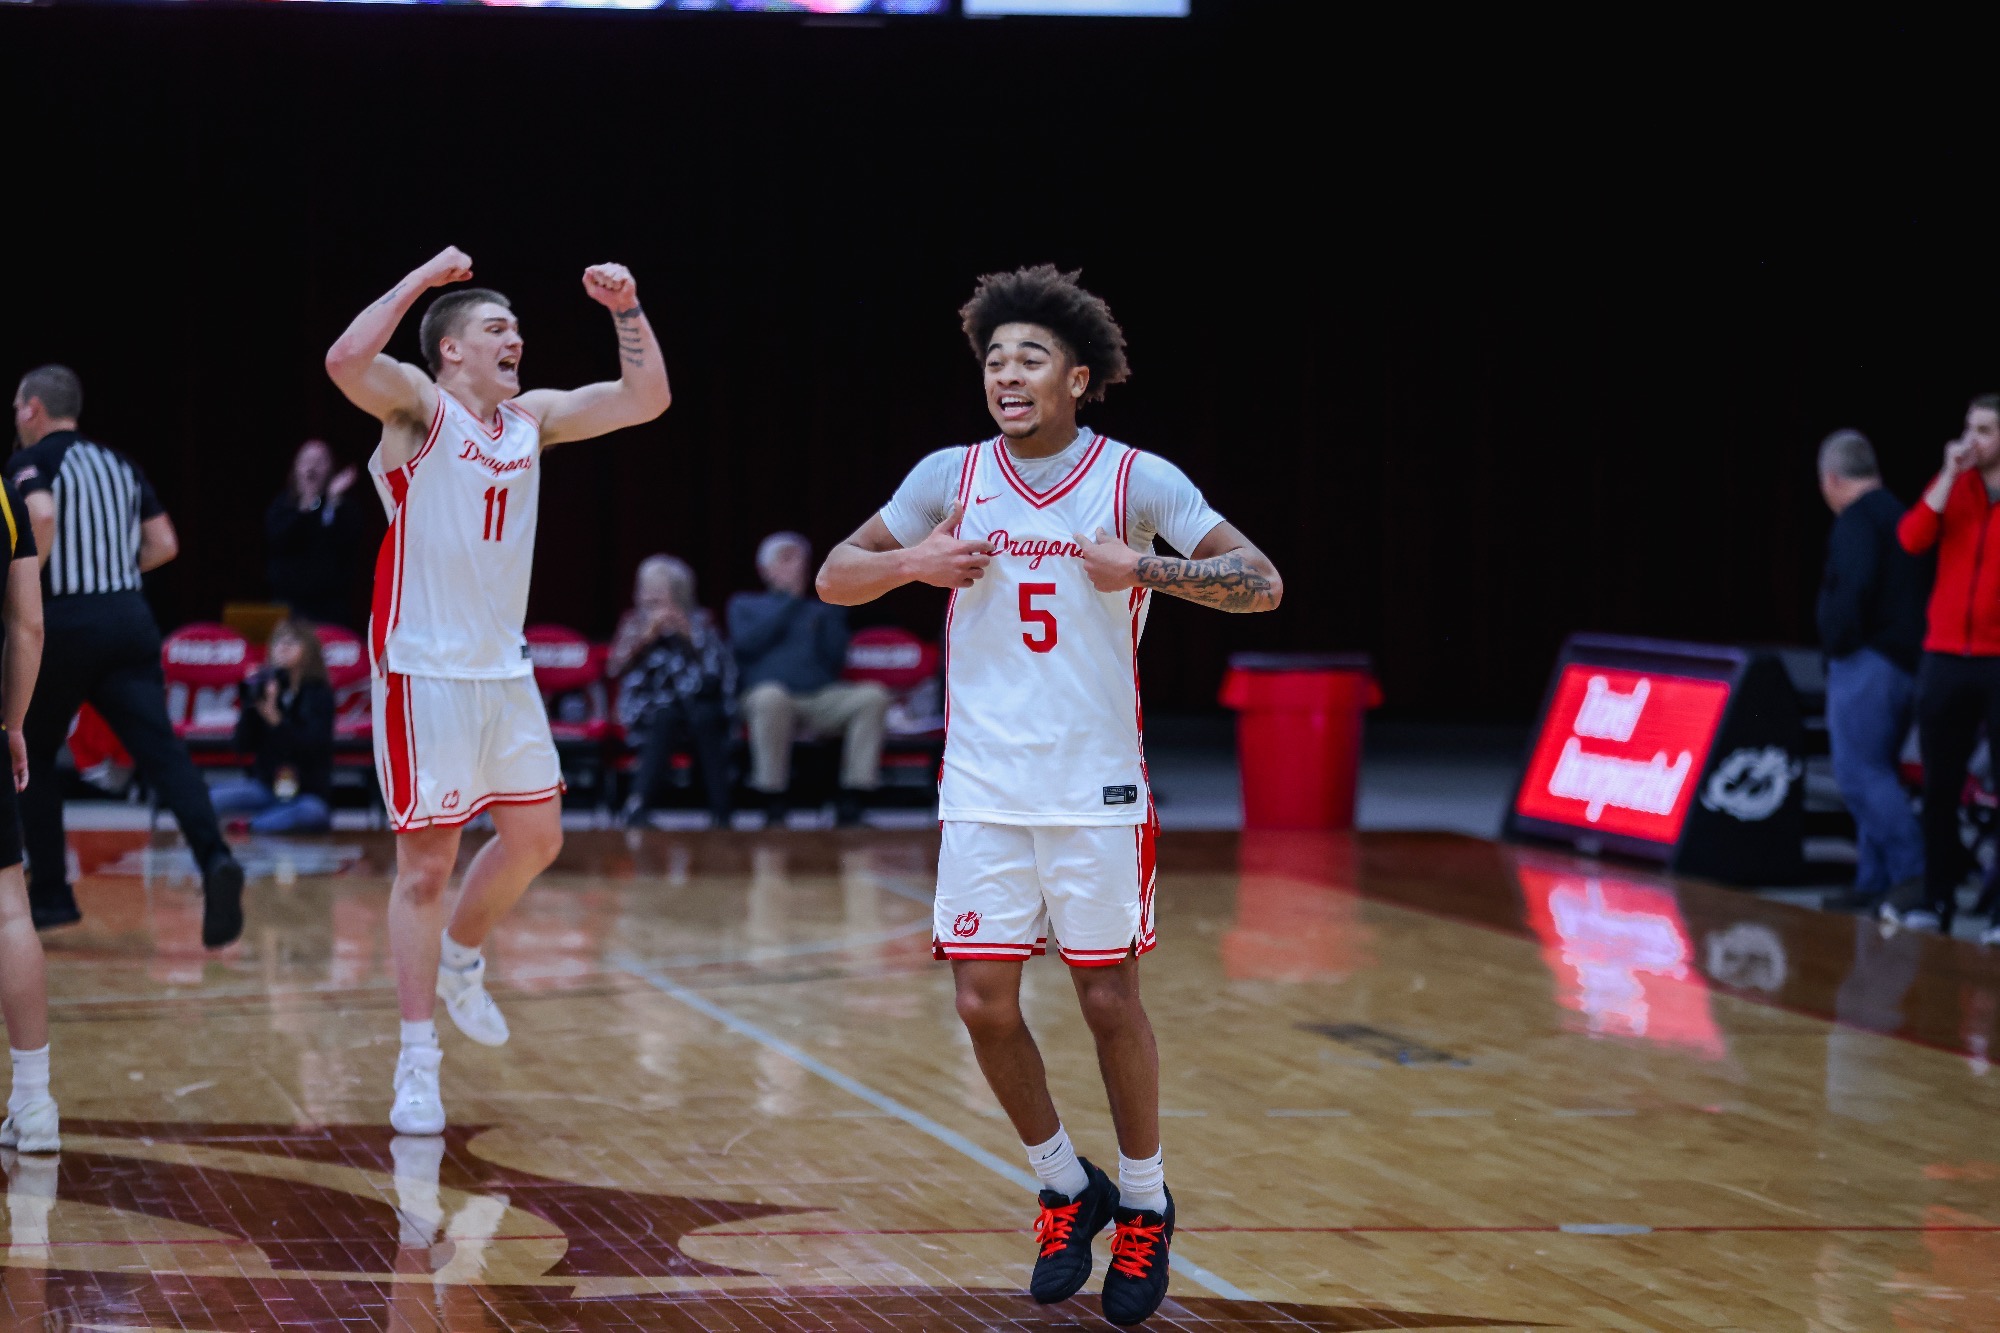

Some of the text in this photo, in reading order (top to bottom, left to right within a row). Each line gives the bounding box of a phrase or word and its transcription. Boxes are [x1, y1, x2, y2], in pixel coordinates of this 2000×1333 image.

[459, 440, 532, 476] Dragons
[483, 486, 508, 541] 11
[1018, 582, 1058, 653] 5
